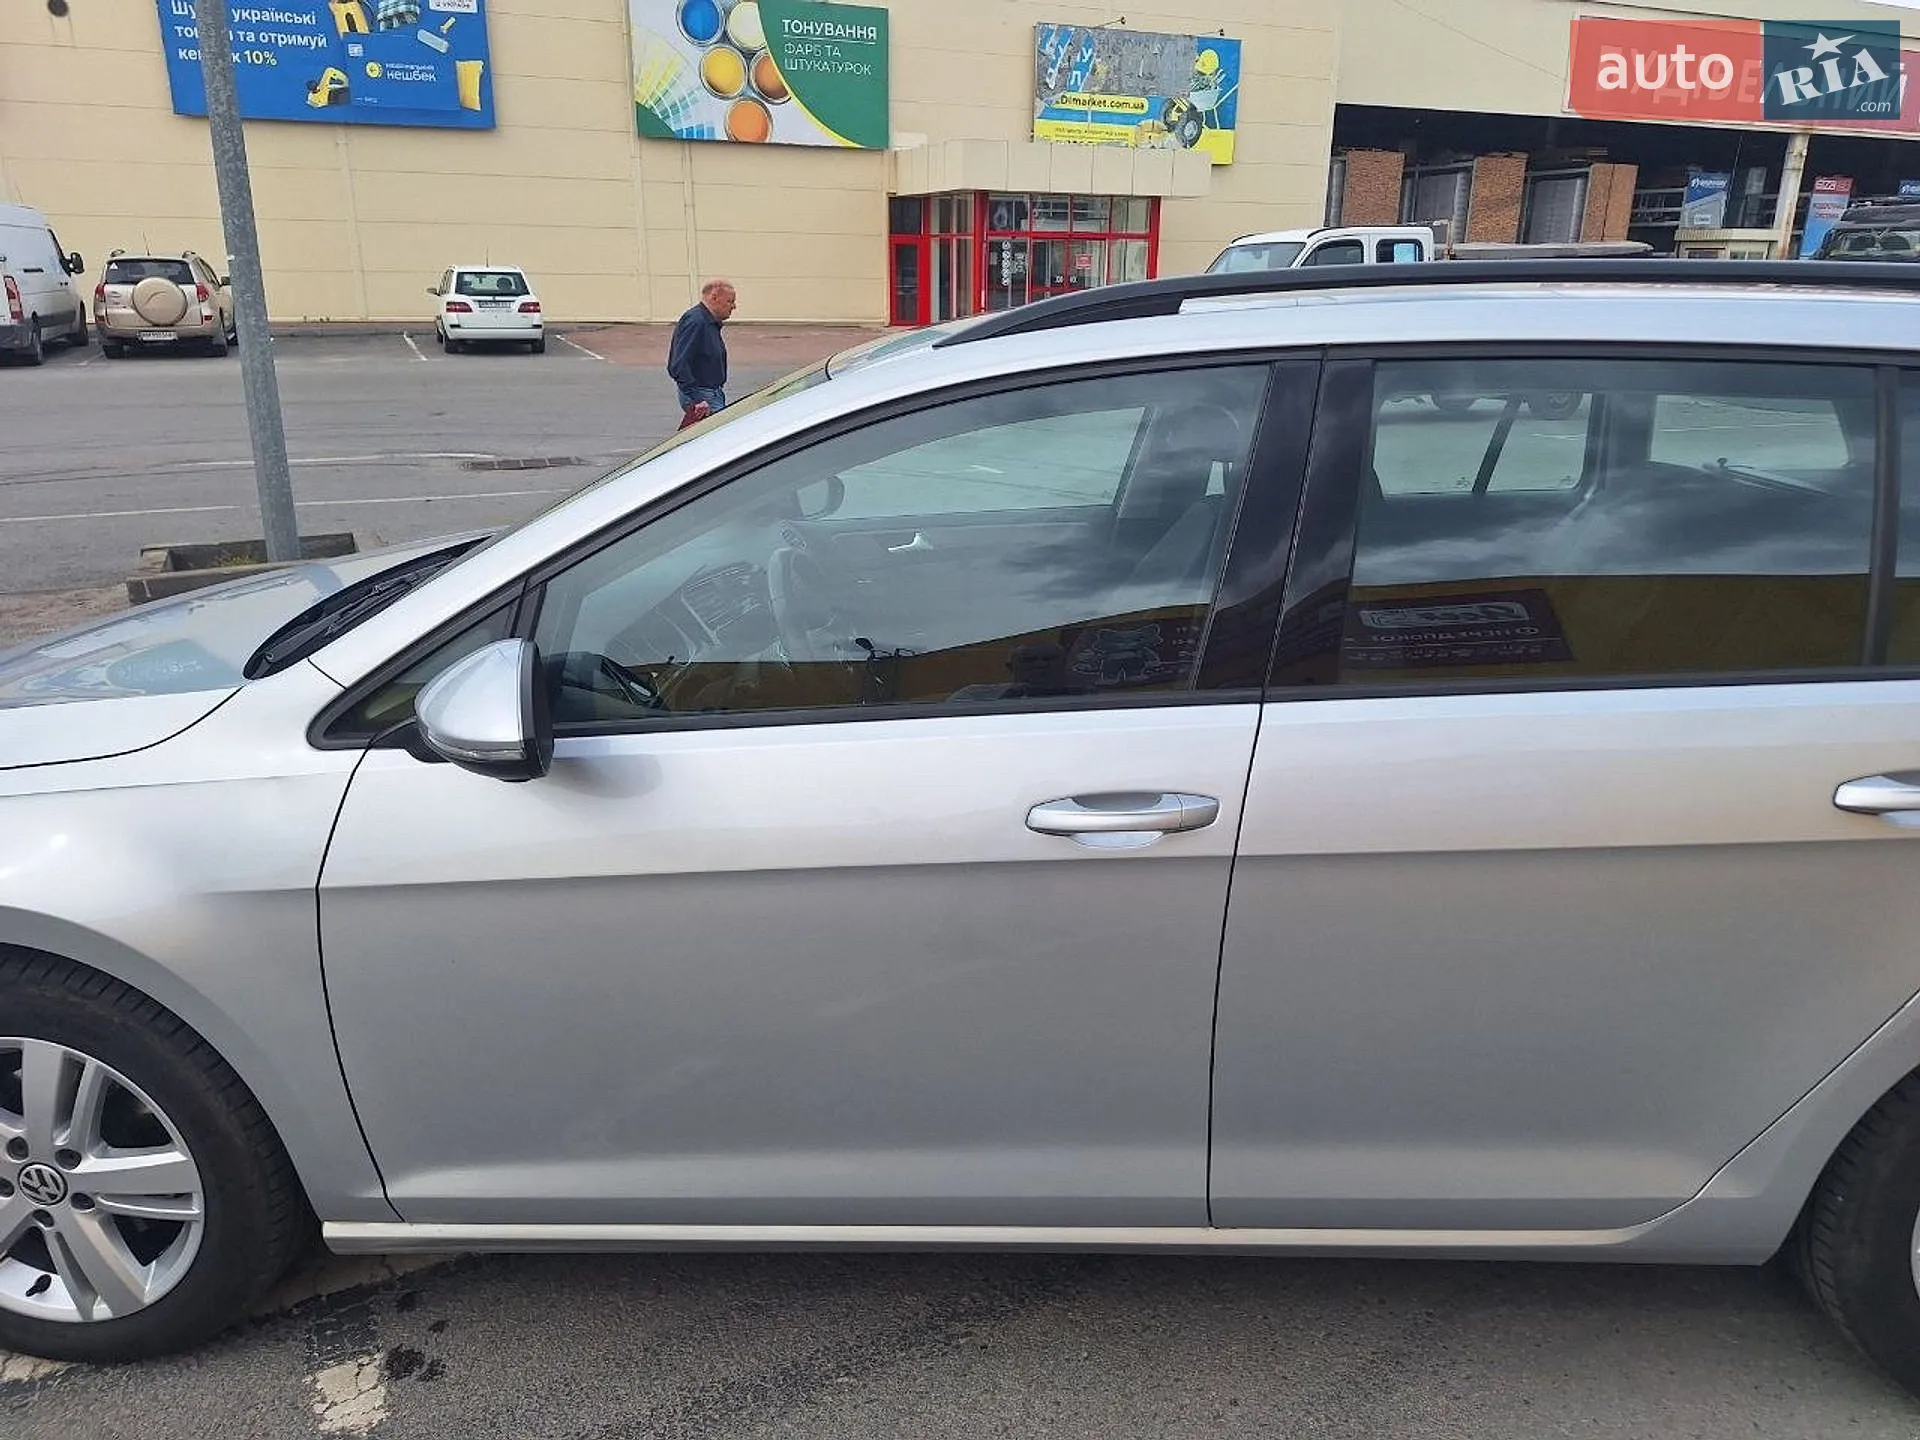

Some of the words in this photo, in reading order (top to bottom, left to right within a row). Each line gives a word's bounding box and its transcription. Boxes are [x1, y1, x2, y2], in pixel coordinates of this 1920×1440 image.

[231, 7, 317, 26] українські
[782, 19, 877, 40] ТОНУВАННЯ
[237, 30, 255, 43] та
[259, 31, 328, 50] отримуй
[243, 50, 278, 66] 10%
[784, 43, 822, 58] ФАРБ
[825, 45, 842, 58] ТА
[386, 69, 437, 82] кешбек
[784, 58, 872, 76] ШТУКАТУРОК
